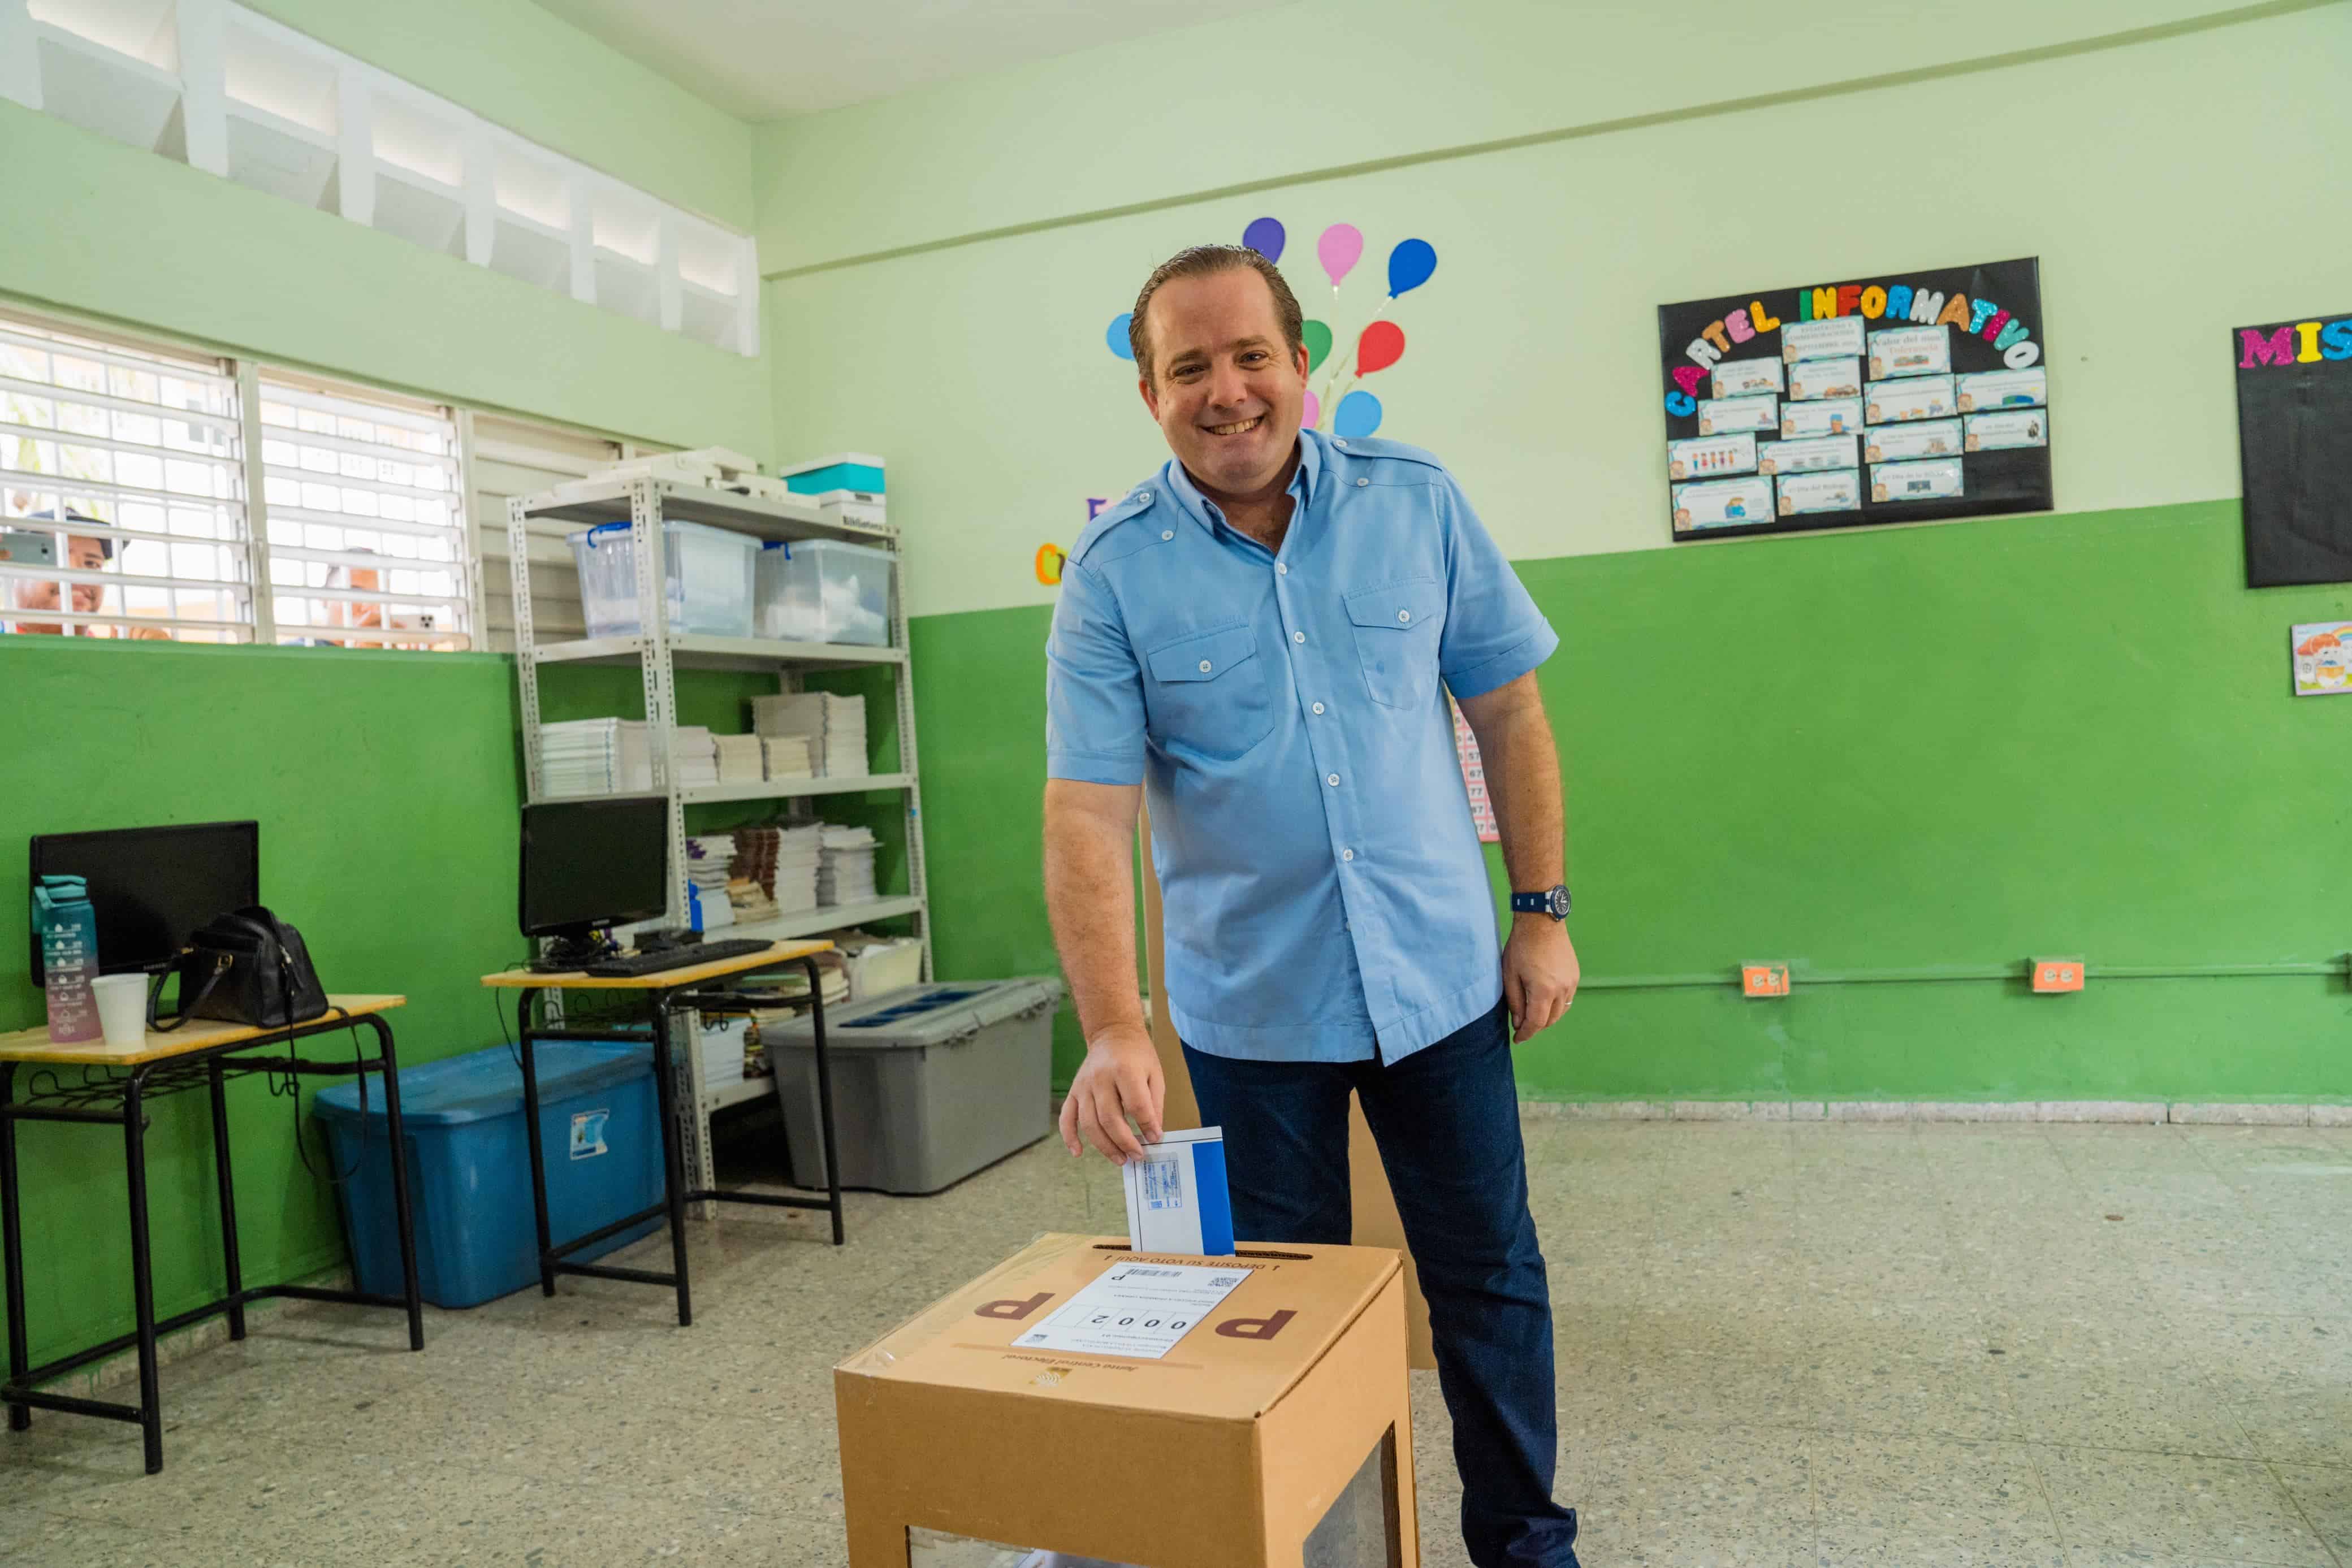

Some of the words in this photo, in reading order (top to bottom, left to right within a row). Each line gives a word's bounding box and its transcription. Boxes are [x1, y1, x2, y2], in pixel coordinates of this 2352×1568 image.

[2238, 319, 2352, 369] MIS
[1664, 301, 1780, 417] CARTEL
[1800, 285, 2039, 370] INFORMATIVO
[1469, 769, 1482, 778] 67
[1471, 787, 1482, 796] 77
[1209, 1261, 1266, 1270] DEPOSITE
[974, 1292, 1056, 1320] P
[1215, 1309, 1299, 1340] P
[1001, 1354, 1056, 1365] Electoral
[1057, 1359, 1101, 1368] Central
[1102, 1363, 1139, 1372] Junta
